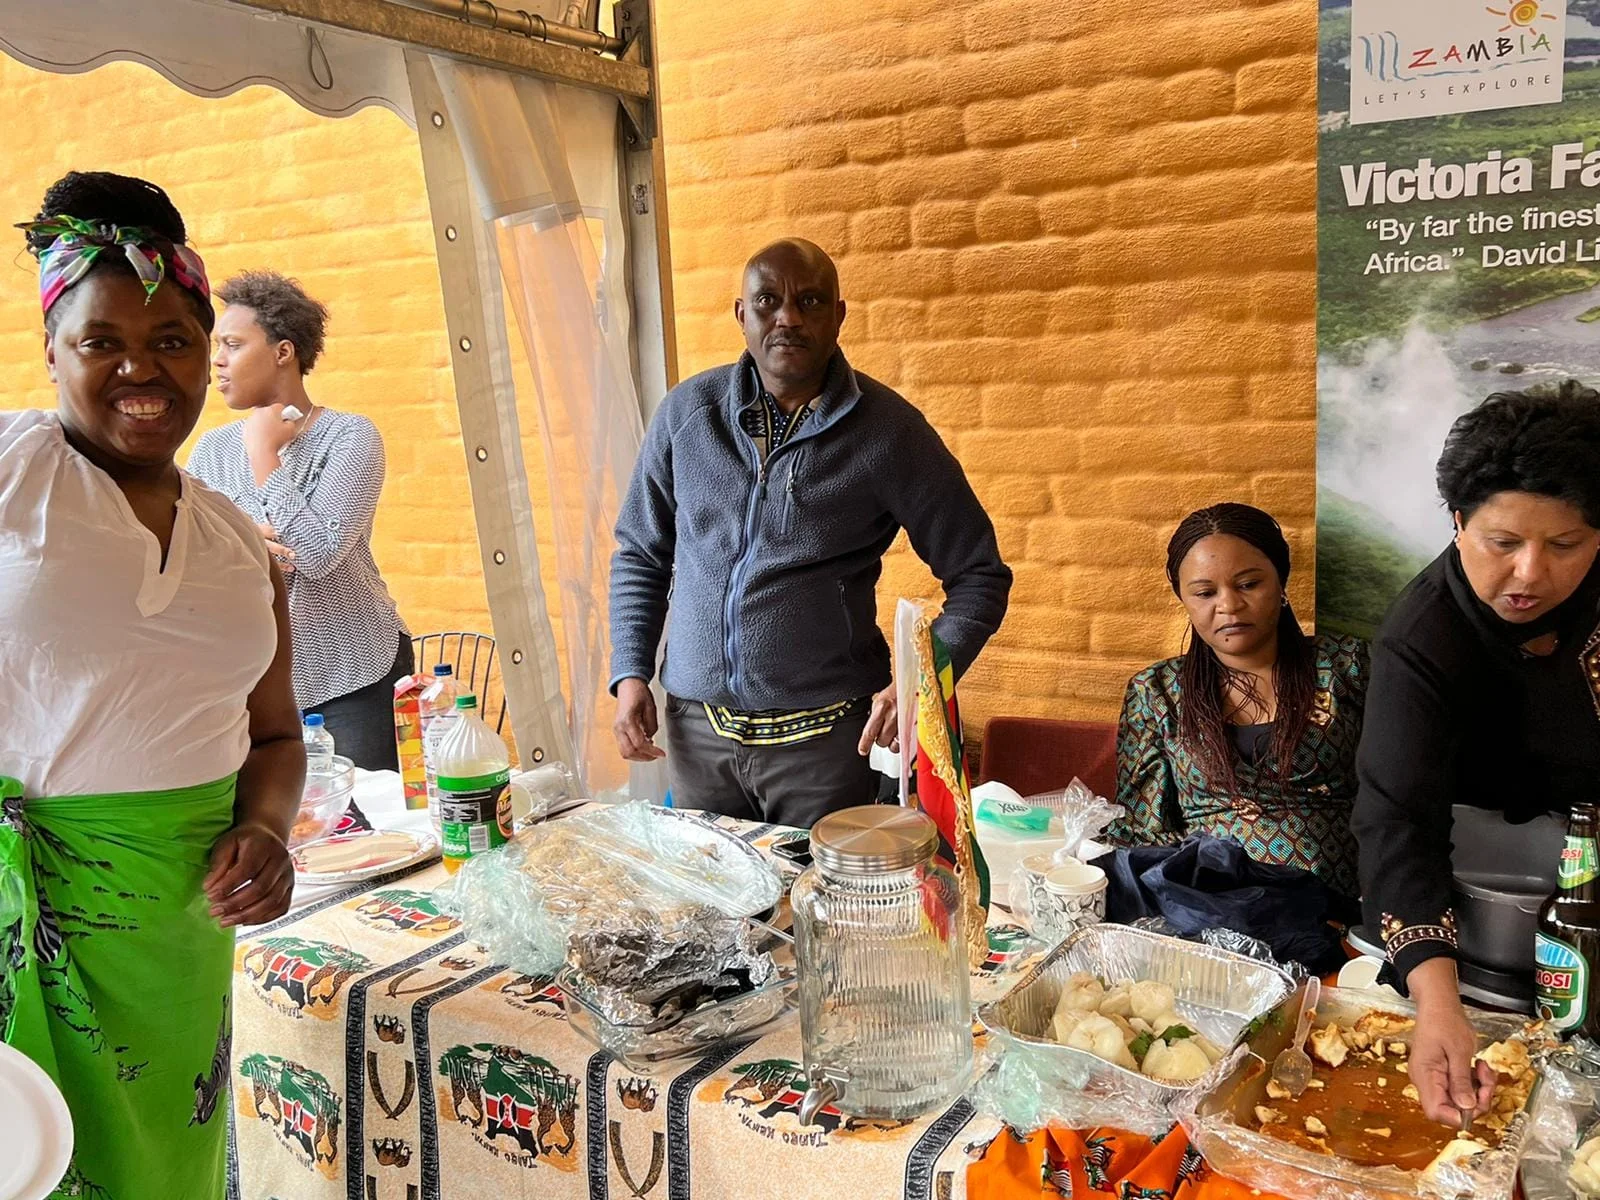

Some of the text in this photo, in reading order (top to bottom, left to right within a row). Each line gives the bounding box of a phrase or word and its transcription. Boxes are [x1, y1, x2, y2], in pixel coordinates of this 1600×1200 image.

[1408, 33, 1552, 69] ZAMBIA
[1364, 75, 1551, 105] LET'S EXPLORE
[1340, 142, 1600, 207] Victoria Fa
[1366, 203, 1600, 246] “By far the finest
[1363, 247, 1465, 275] Africa.”
[1482, 240, 1567, 268] David
